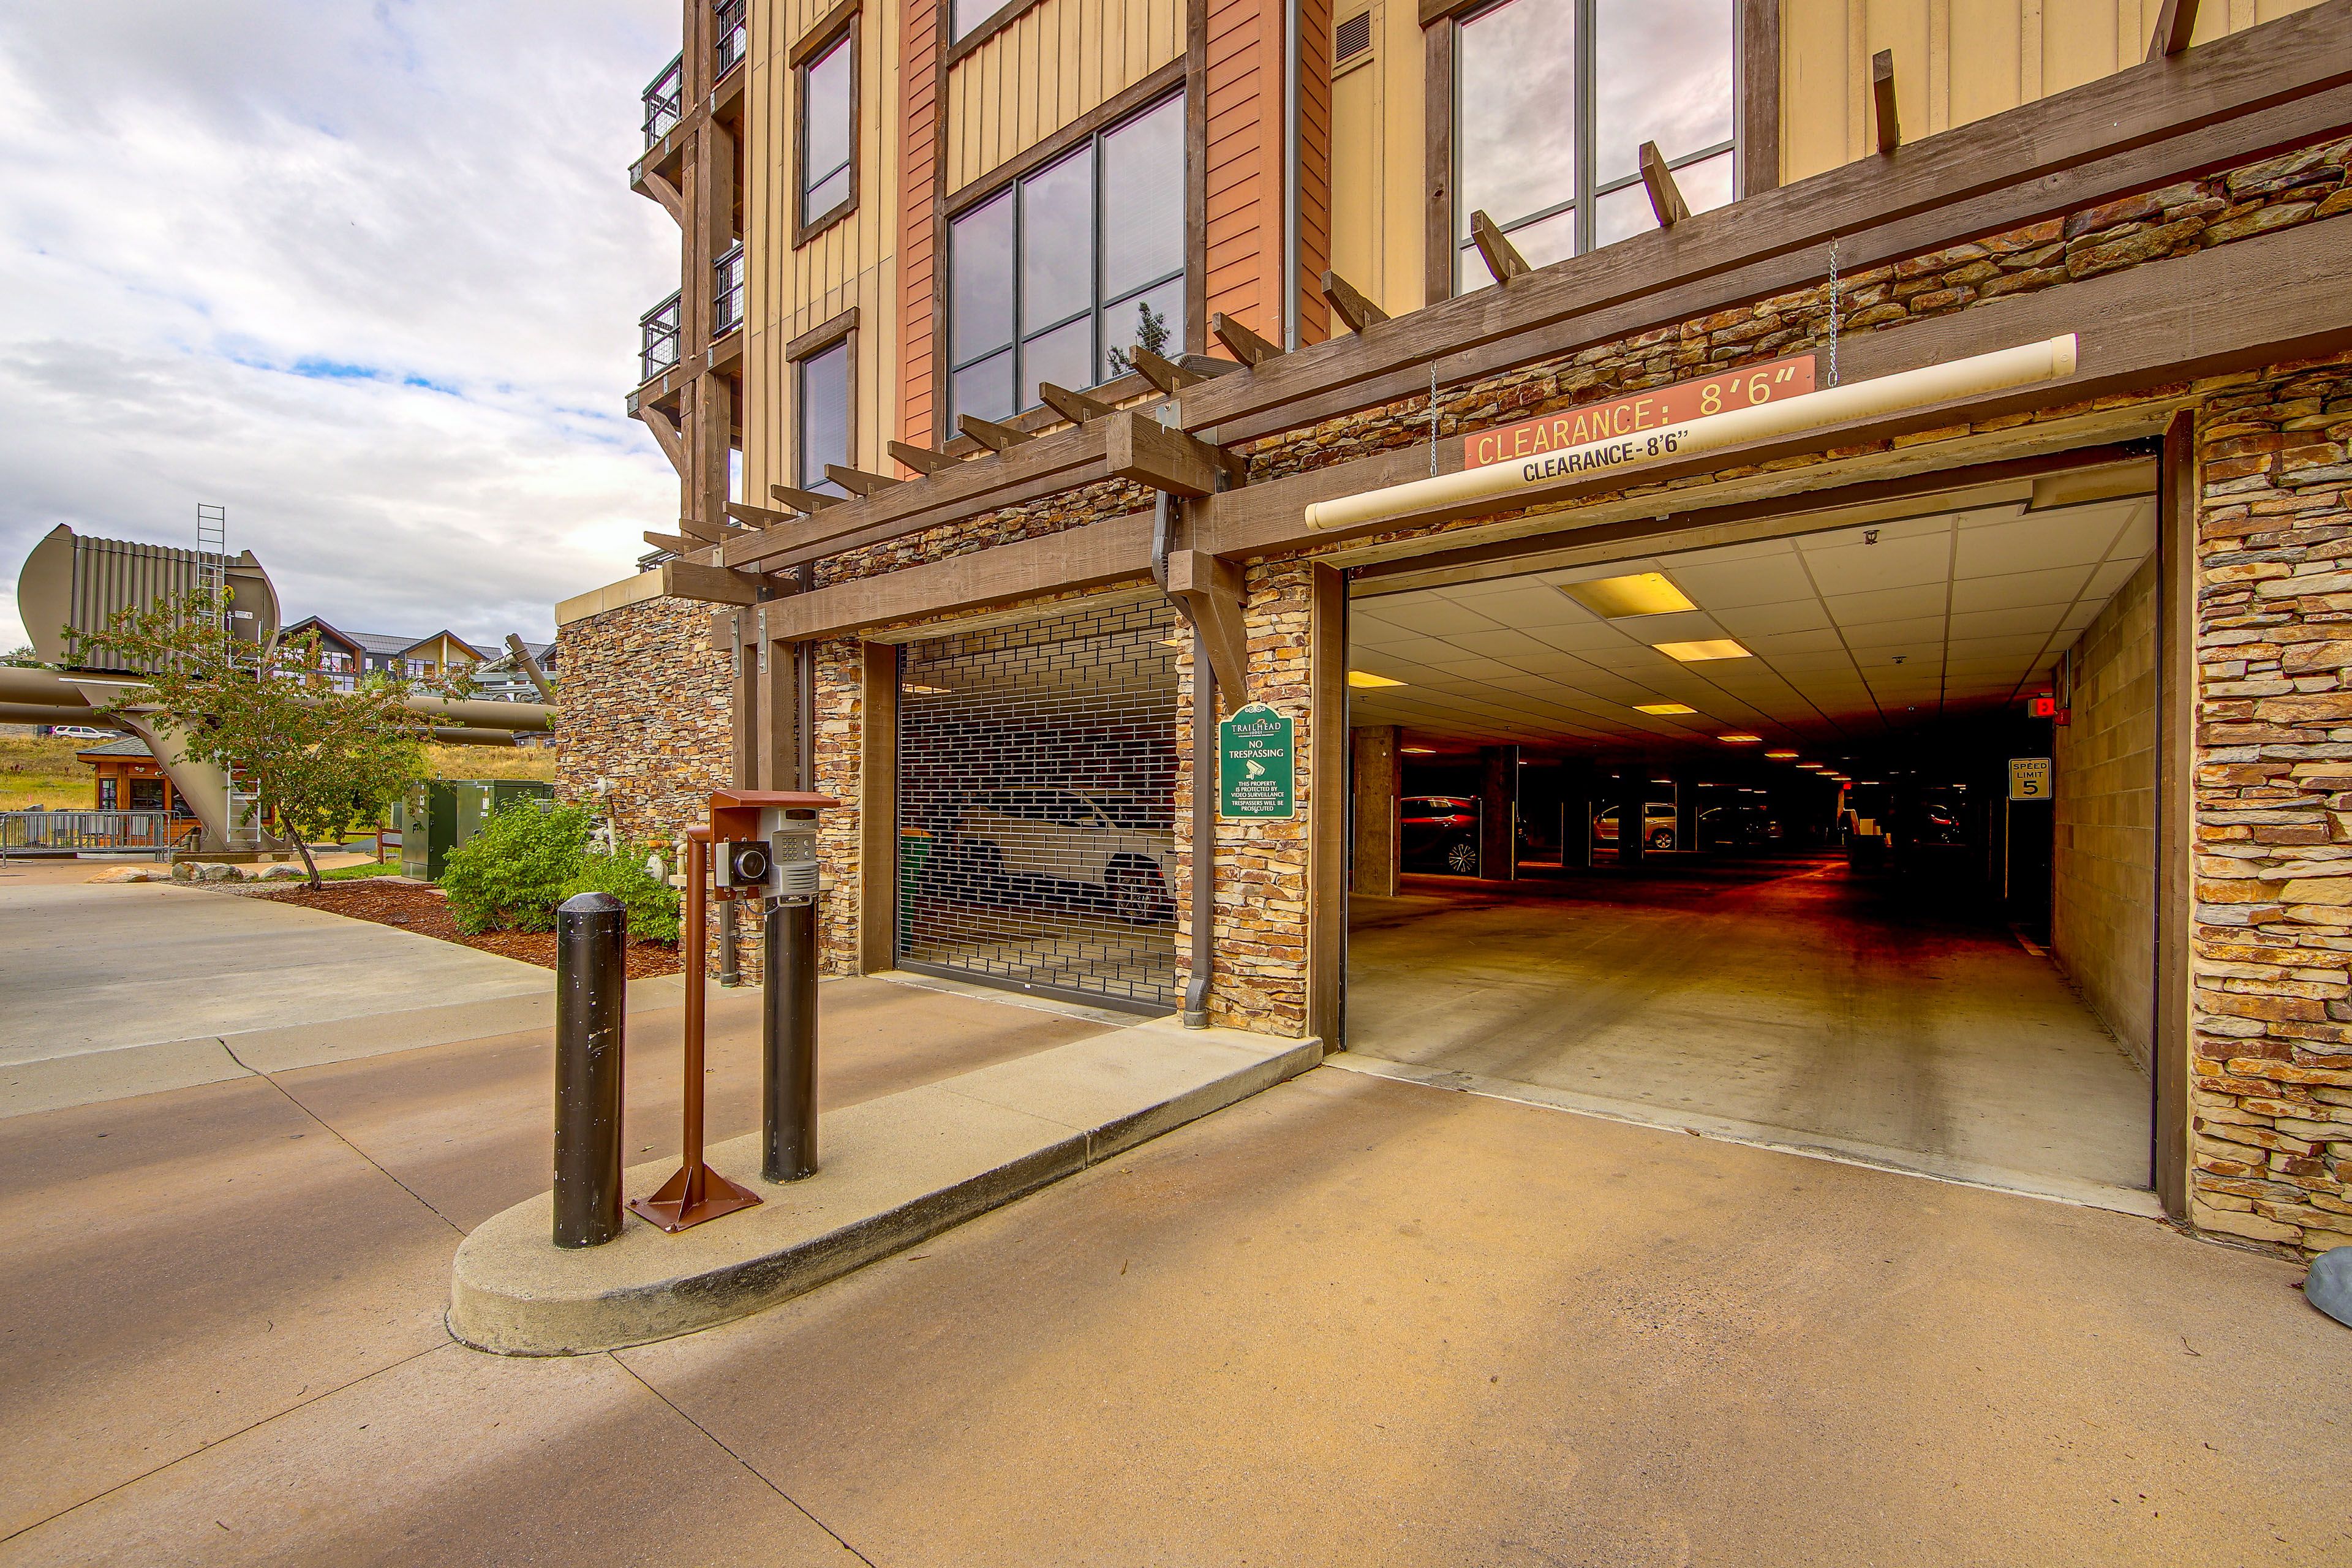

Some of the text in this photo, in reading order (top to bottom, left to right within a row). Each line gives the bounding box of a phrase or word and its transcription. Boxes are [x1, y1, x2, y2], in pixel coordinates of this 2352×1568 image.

[1478, 398, 1668, 465] CLEARANCE:
[1232, 723, 1281, 732] TRAILHEAD
[1229, 749, 1283, 758] TRESPASSING
[2023, 780, 2038, 795] 5
